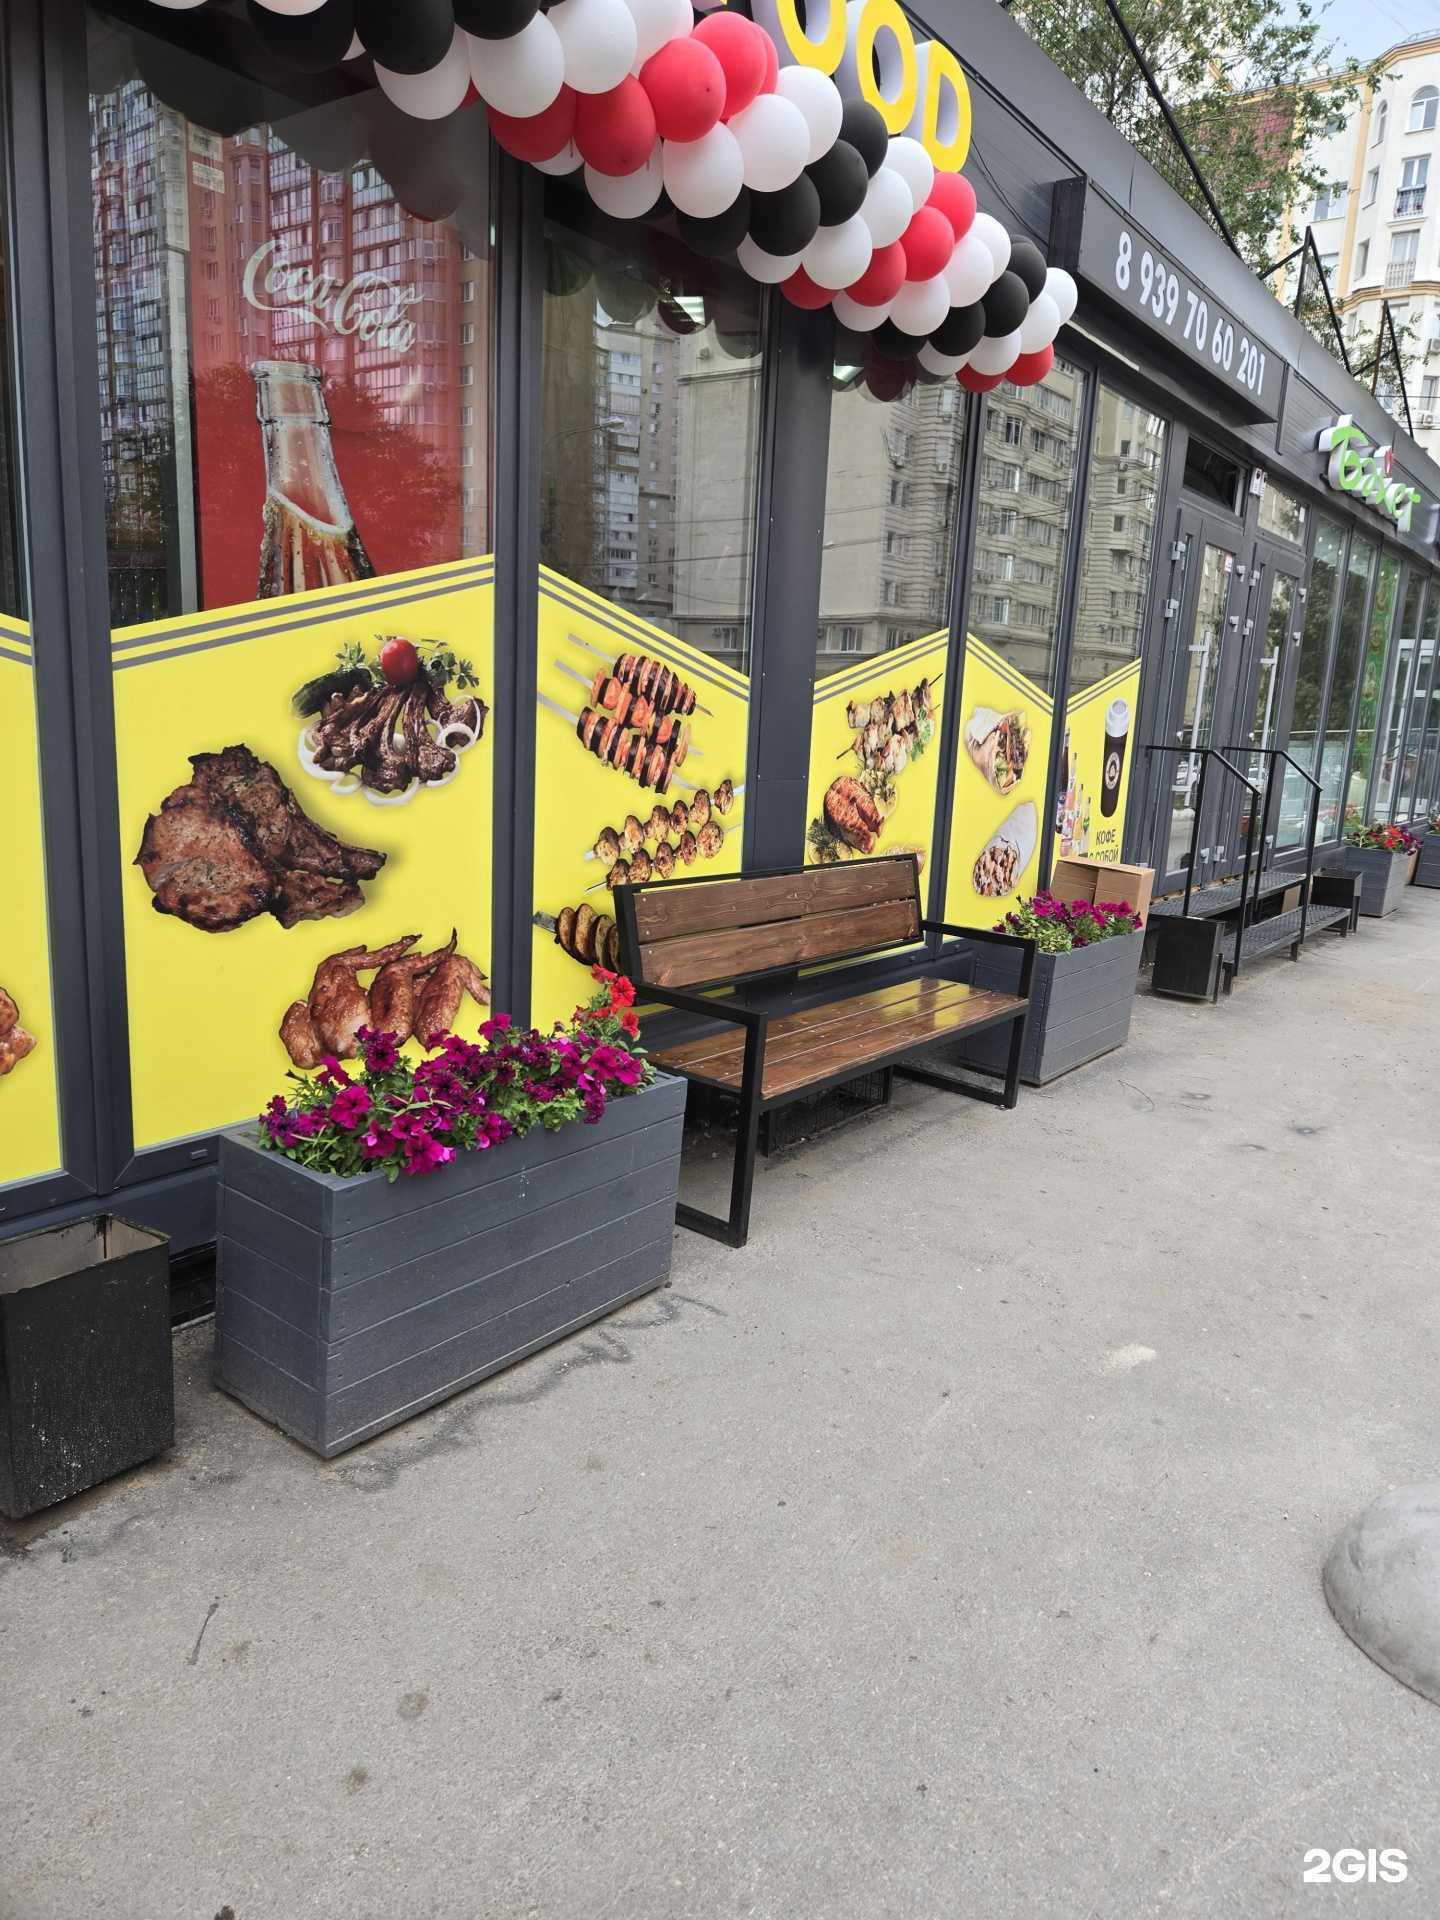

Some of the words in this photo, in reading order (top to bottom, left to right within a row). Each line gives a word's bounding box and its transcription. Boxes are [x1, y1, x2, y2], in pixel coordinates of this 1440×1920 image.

[1115, 231, 1132, 291] 8
[1139, 250, 1180, 326] 939
[1183, 289, 1208, 351] 70
[1212, 318, 1234, 371] 60
[1236, 336, 1265, 396] 201
[1095, 828, 1117, 846] КОФЕ
